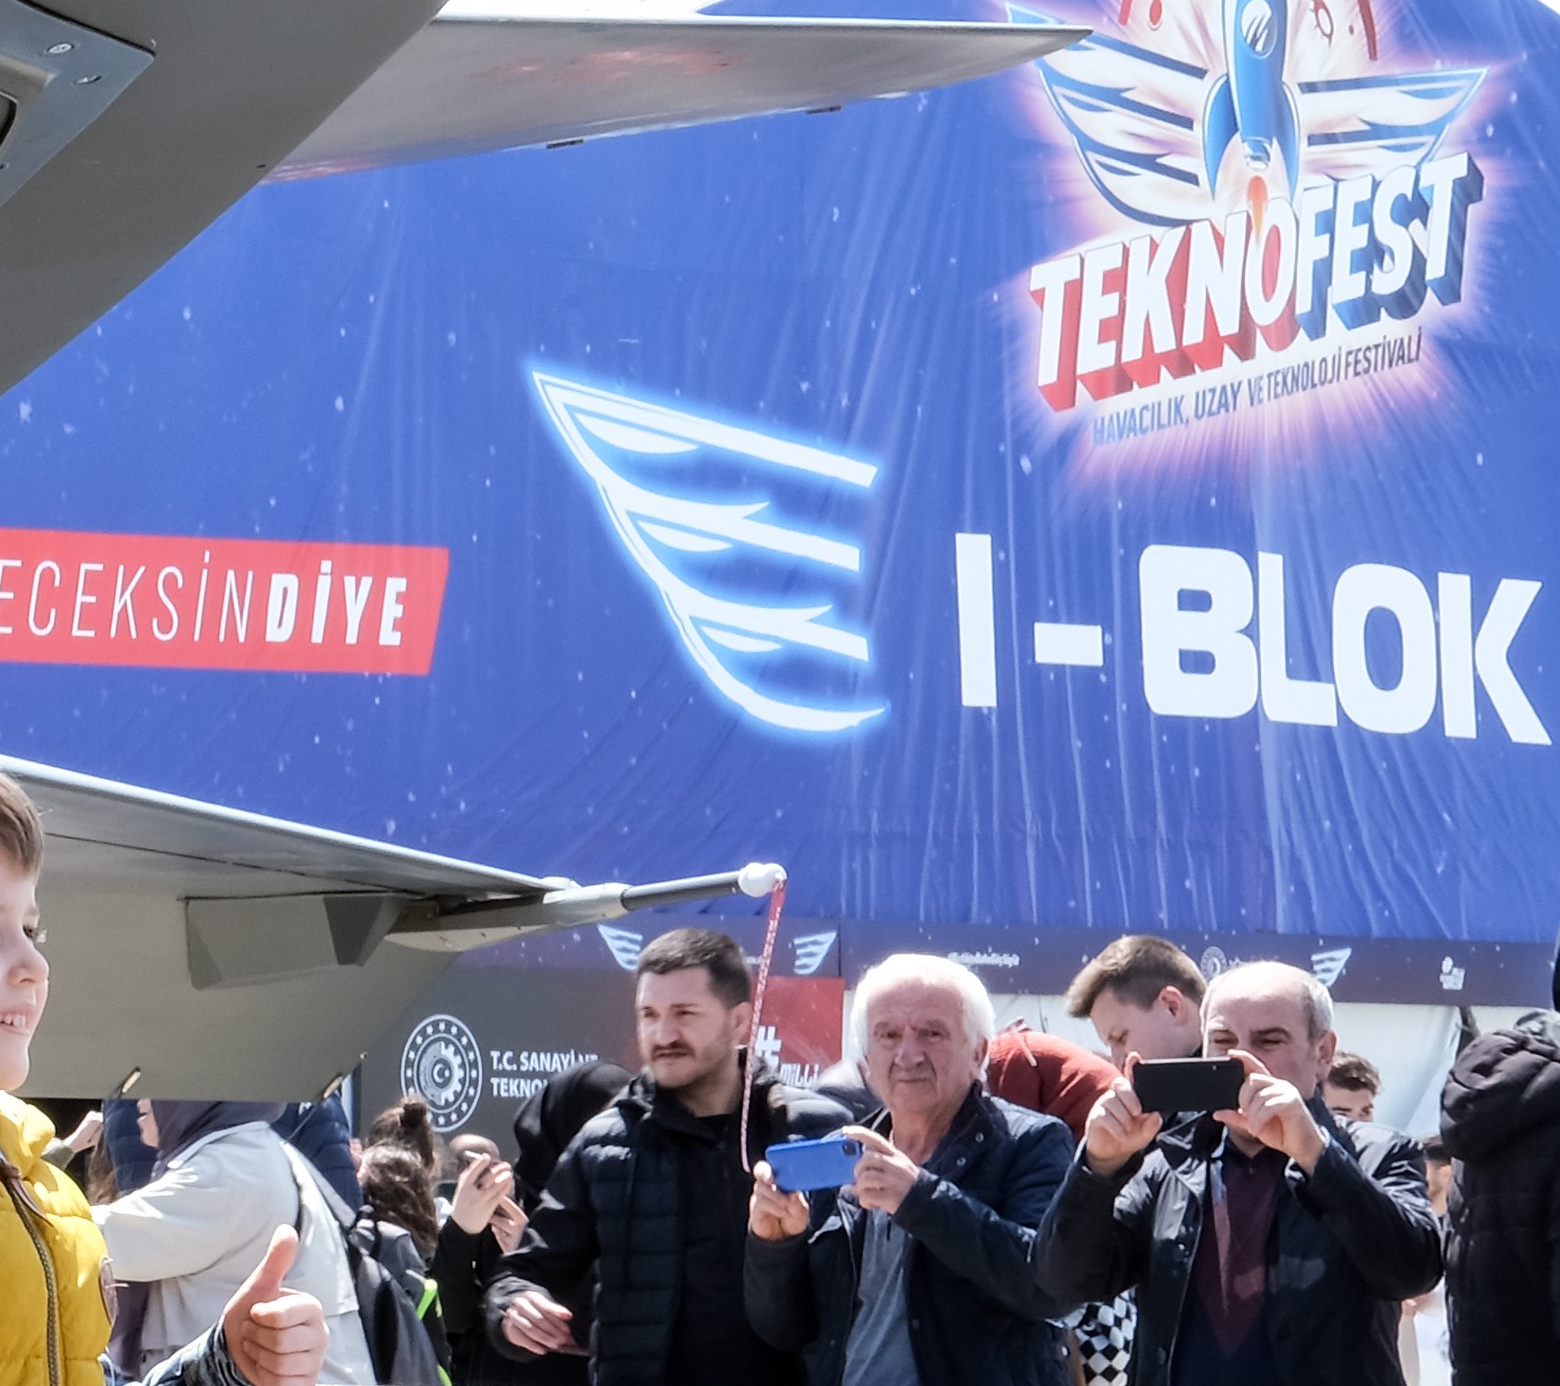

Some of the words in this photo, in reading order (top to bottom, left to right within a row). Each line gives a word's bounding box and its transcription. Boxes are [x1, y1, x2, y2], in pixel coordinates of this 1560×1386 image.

[1029, 151, 1478, 403] TEKNOFEST
[1194, 381, 1243, 421] UZAY
[1248, 380, 1264, 407] VE
[1265, 351, 1343, 404] TEKNOLOJİ
[1343, 325, 1424, 382] FESTİVALİ
[1138, 544, 1554, 747] BLOK
[490, 1050, 518, 1071] T.C.
